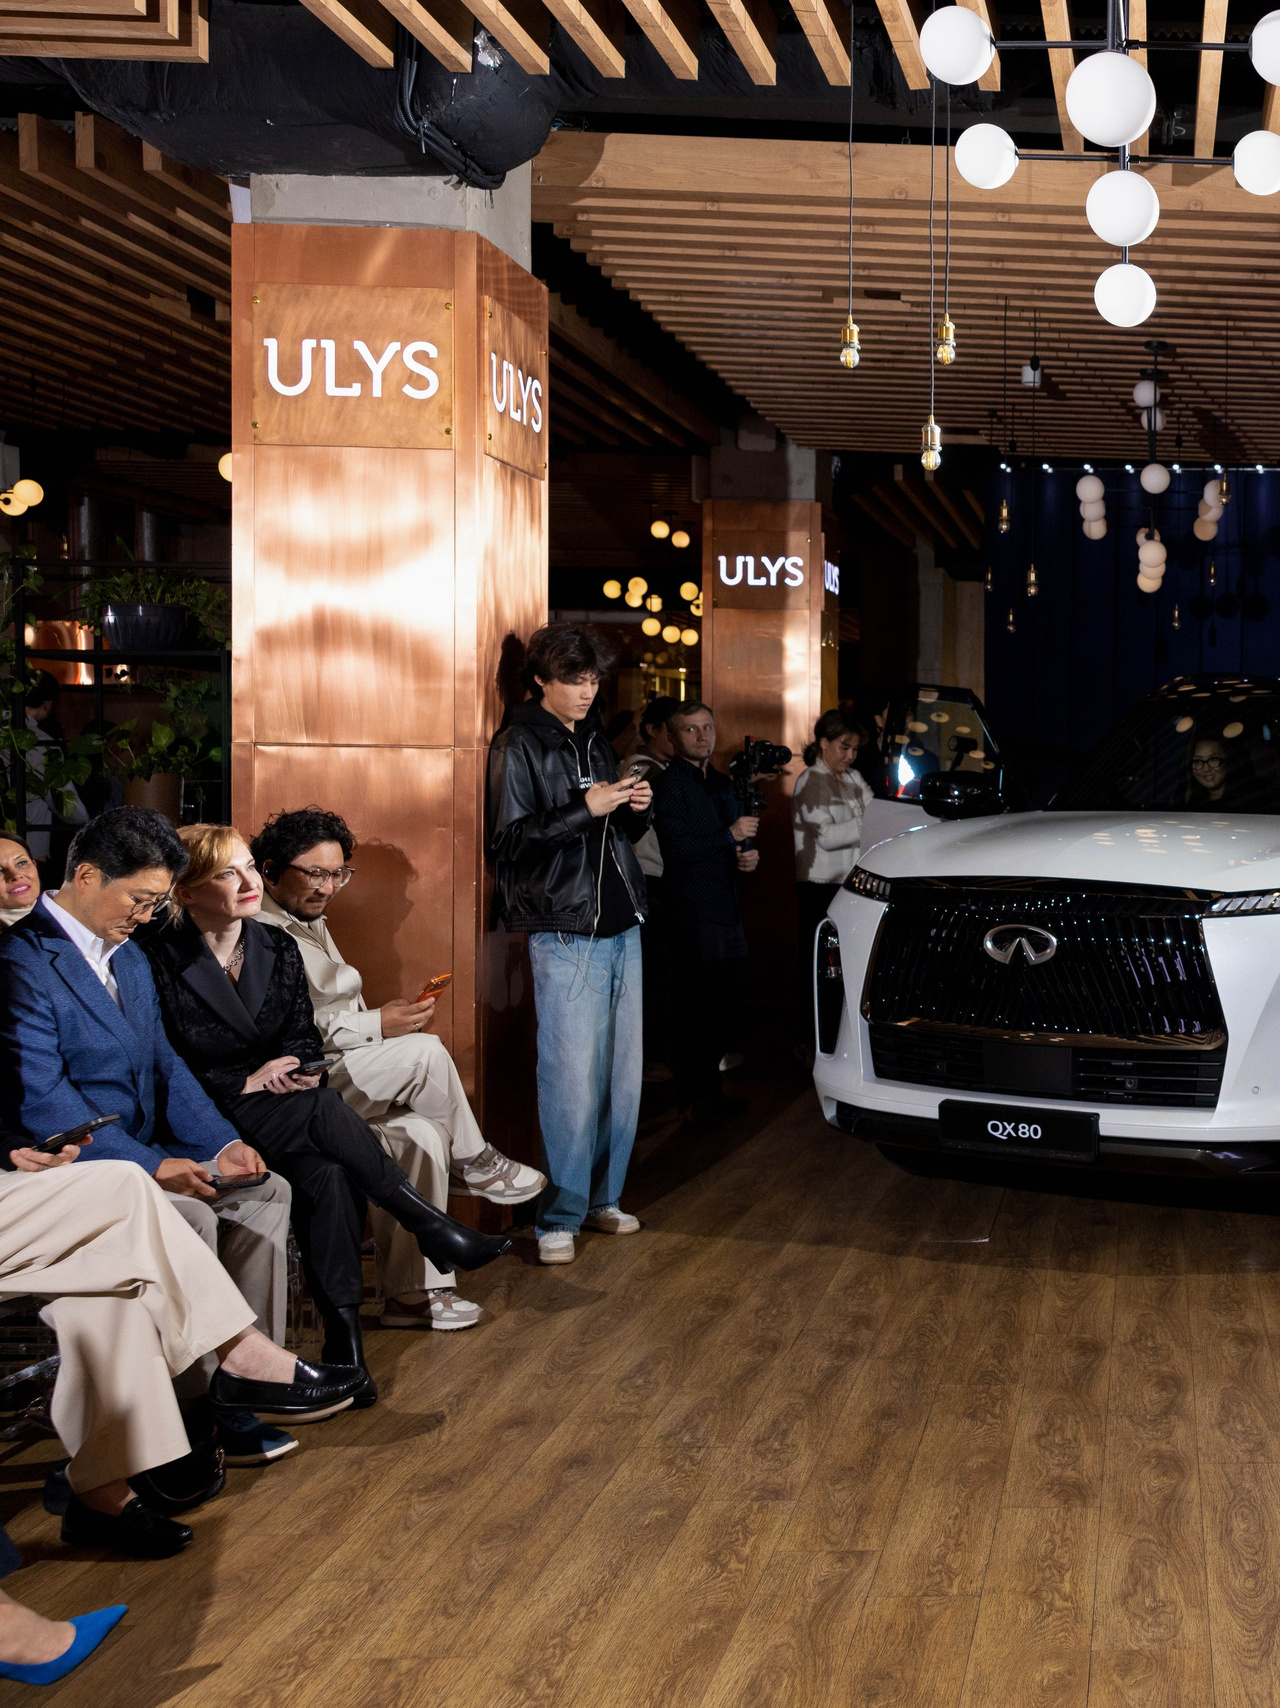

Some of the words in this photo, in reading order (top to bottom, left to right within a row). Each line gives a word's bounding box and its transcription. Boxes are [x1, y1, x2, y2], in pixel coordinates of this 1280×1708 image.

[263, 337, 440, 400] ULYS
[491, 352, 542, 433] ULYS
[718, 555, 804, 587] ULYS
[987, 1120, 1042, 1140] QX80
